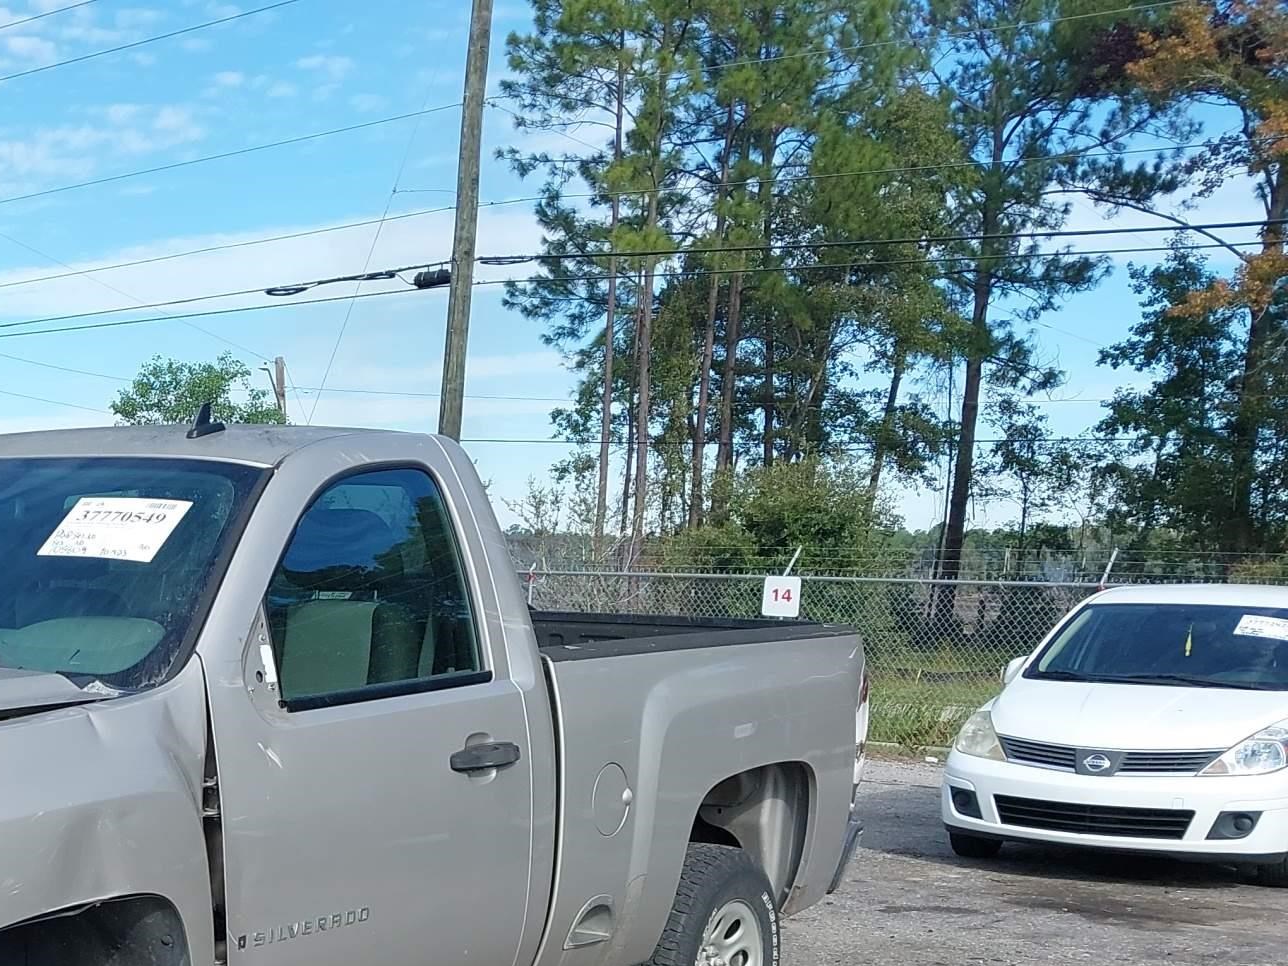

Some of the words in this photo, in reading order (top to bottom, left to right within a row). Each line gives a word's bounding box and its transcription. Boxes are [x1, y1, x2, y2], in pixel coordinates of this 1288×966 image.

[75, 510, 167, 524] 37770549
[772, 588, 793, 602] 14
[254, 905, 370, 947] SILVERADO
